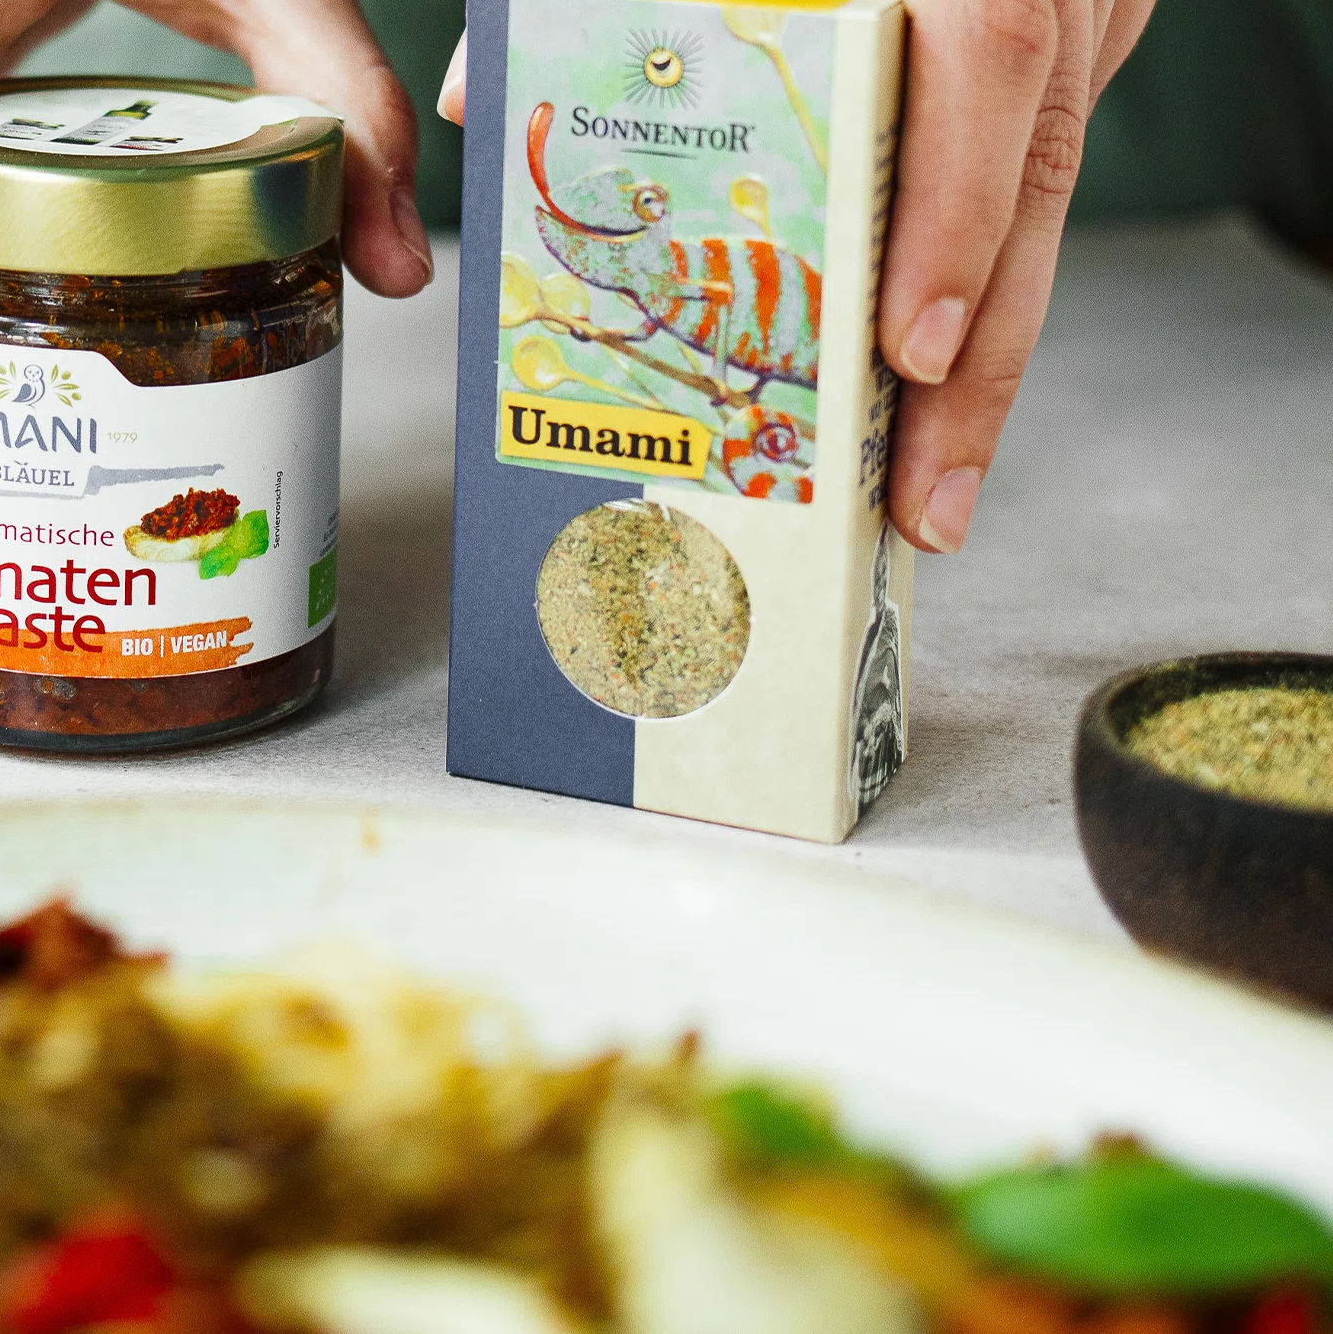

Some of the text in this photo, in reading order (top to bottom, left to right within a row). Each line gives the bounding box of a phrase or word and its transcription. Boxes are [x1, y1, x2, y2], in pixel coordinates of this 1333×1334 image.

[570, 106, 750, 153] SONNENTOR
[106, 431, 138, 444] 1979
[508, 405, 692, 466] Umami
[273, 470, 284, 549] Serviervorschlag
[121, 630, 228, 657] BIO VEGAN
